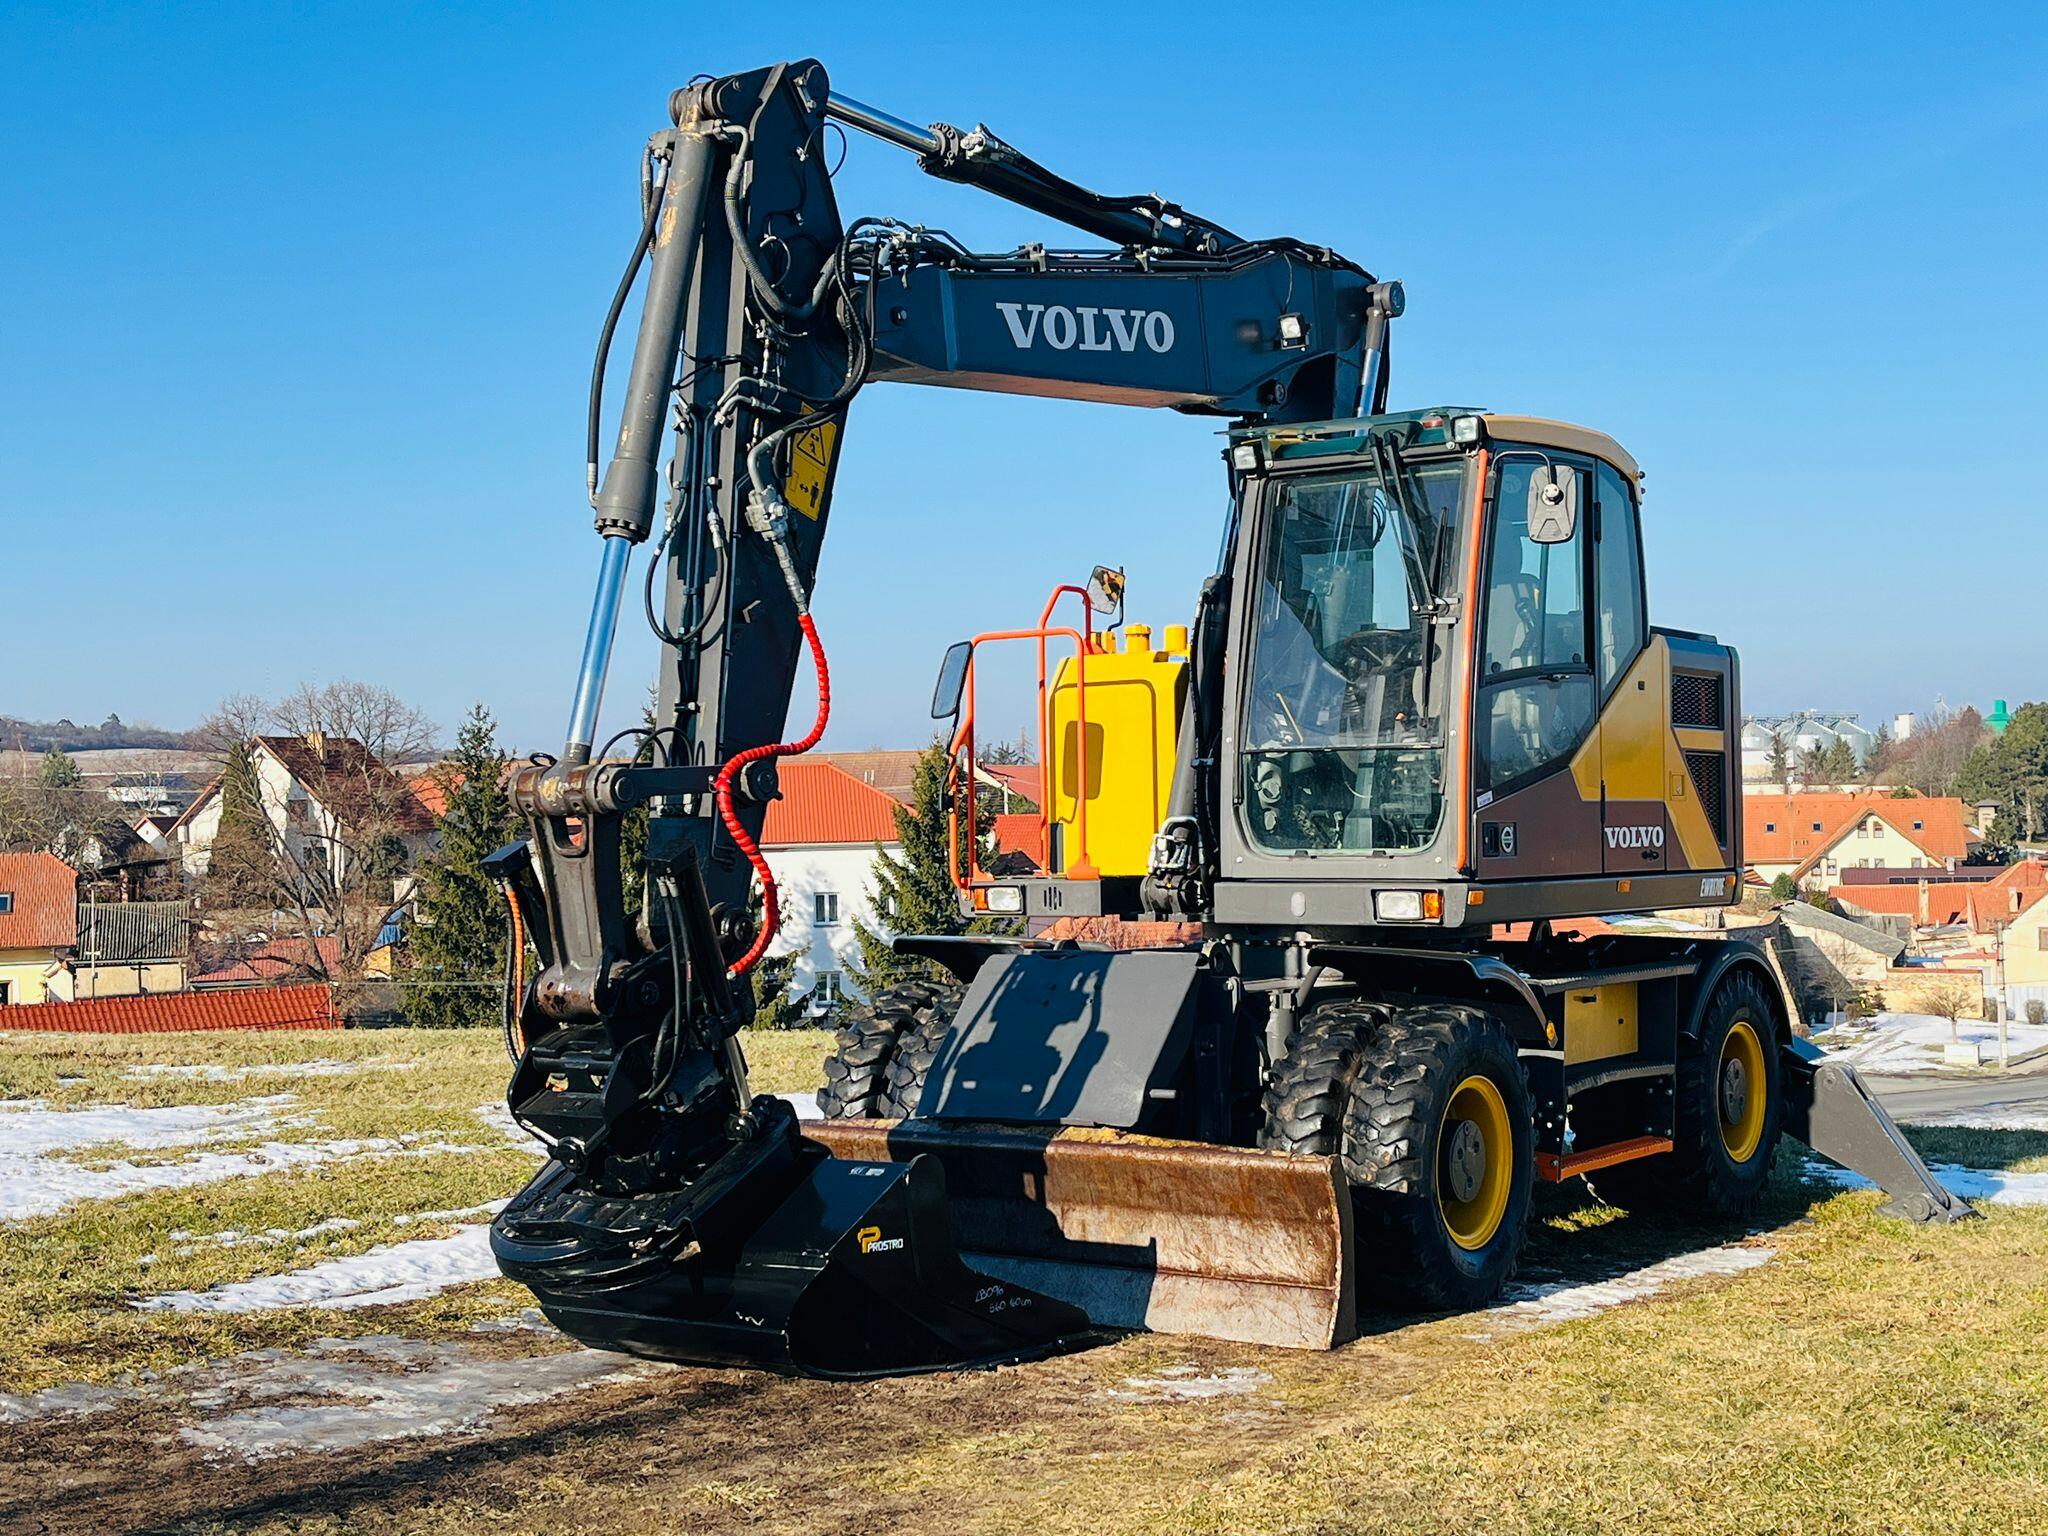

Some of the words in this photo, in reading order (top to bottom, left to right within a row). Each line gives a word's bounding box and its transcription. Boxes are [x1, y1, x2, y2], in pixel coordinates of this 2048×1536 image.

[996, 302, 1175, 353] VOLVO
[1604, 826, 1664, 849] VOLVO
[867, 1238, 904, 1253] PROSTRO
